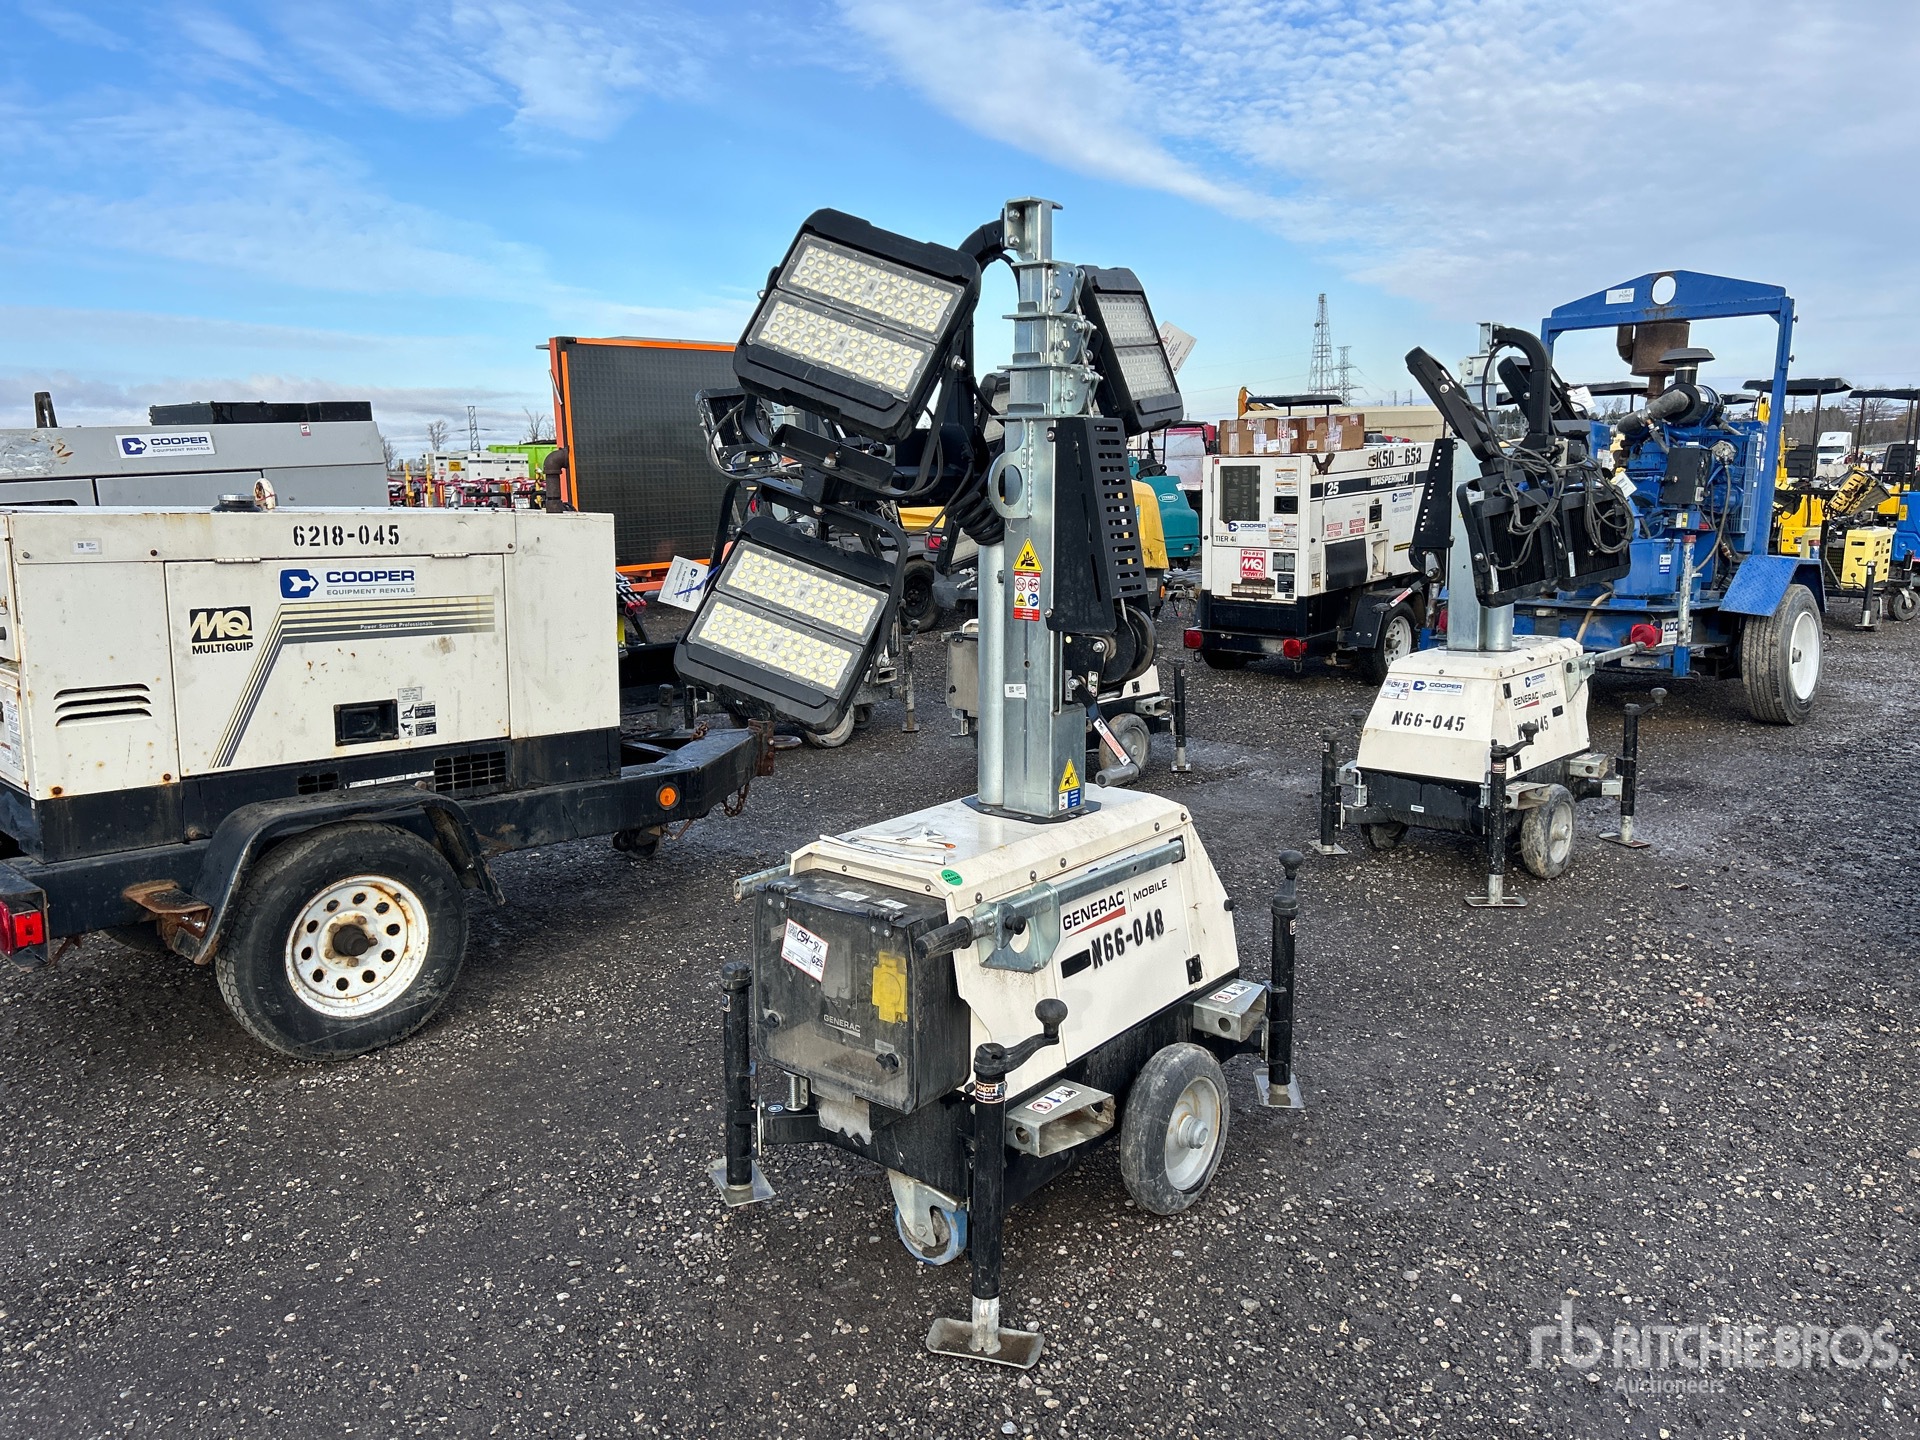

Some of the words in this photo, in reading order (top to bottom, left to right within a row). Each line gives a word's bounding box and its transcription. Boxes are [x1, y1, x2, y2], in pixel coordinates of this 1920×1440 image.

[150, 436, 208, 446] COOPER
[1376, 450, 1394, 468] K50
[1404, 447, 1422, 465] 653
[1326, 482, 1340, 496] 25
[293, 524, 400, 546] 6218-045
[1242, 558, 1264, 571] MQ
[326, 570, 415, 582] COOPER
[192, 610, 252, 640] MQ
[192, 642, 254, 655] MULTIQUIP
[1514, 691, 1540, 706] GENERAC
[1542, 690, 1558, 699] MOBILE
[1391, 710, 1466, 732] N66-045
[1062, 890, 1126, 931] GENERAC
[1133, 878, 1168, 902] MOBILE
[1091, 908, 1164, 970] N66-048
[824, 1014, 860, 1032] GENERAC
